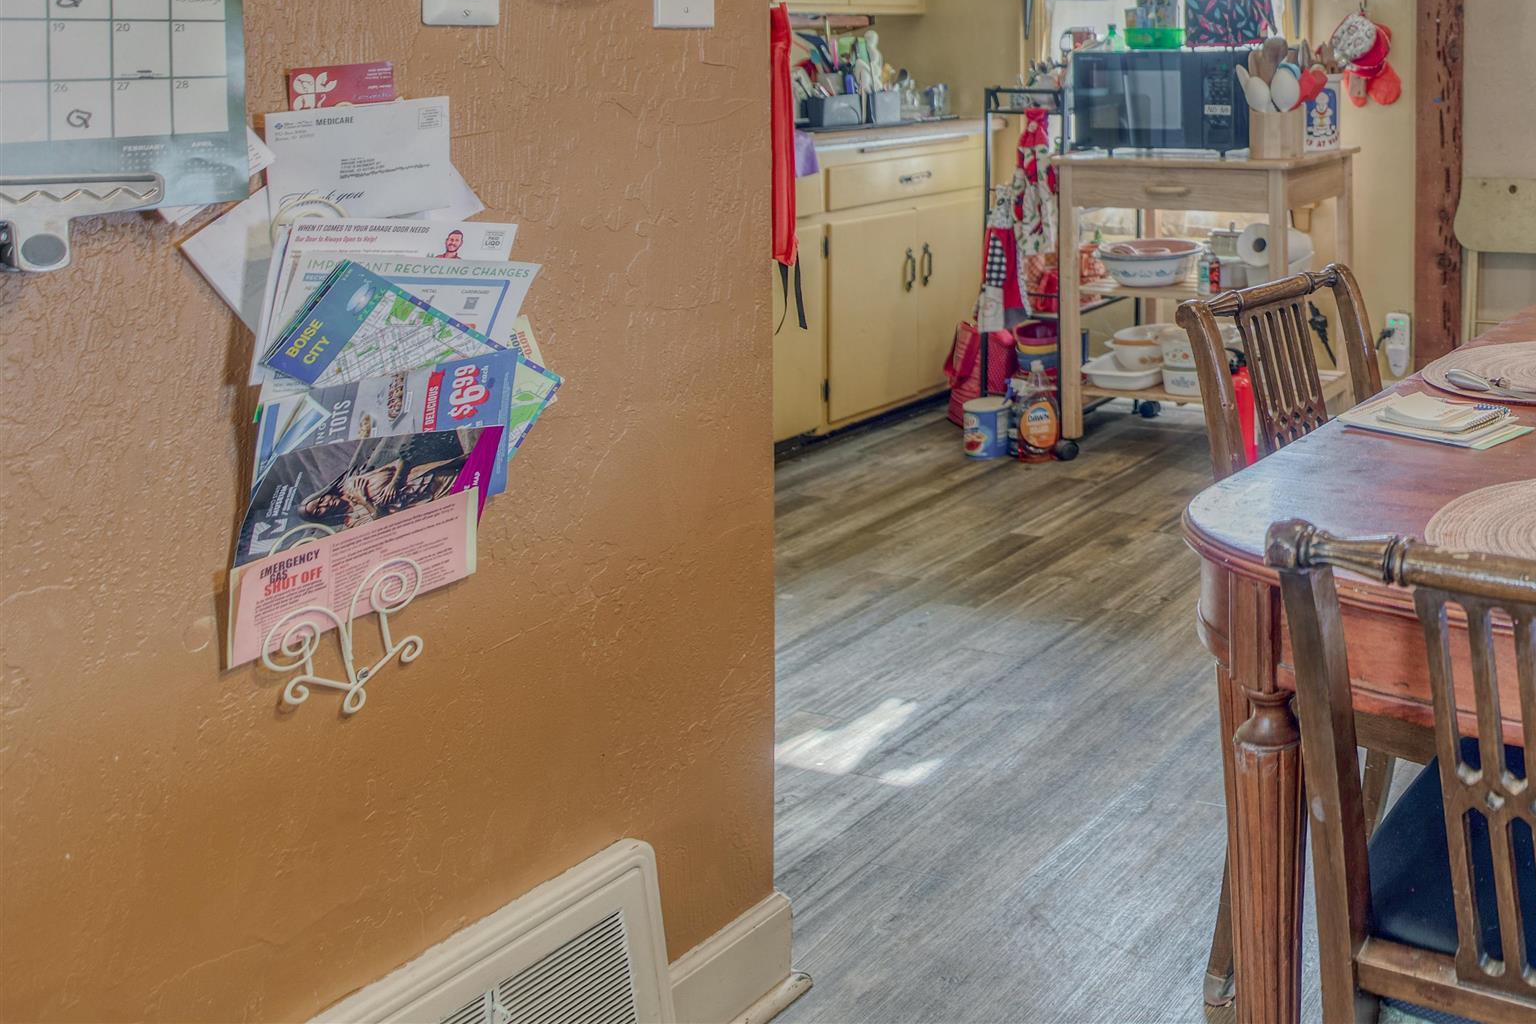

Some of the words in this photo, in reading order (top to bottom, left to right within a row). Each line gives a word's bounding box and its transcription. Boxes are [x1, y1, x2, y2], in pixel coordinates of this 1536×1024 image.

[53, 22, 66, 32] 19
[115, 23, 131, 33] 20
[174, 23, 186, 33] 21
[53, 83, 68, 93] 26
[116, 81, 130, 91] 27
[175, 80, 190, 90] 28
[315, 116, 355, 127] MEDICARE
[122, 144, 166, 153] FEBRUARY
[191, 141, 214, 149] APRIL
[335, 190, 366, 205] you
[297, 224, 316, 232] WHEN
[323, 224, 344, 233] COMES
[344, 225, 353, 233] TO
[353, 225, 369, 233] YOUR
[369, 225, 391, 233] GARAGE
[392, 226, 410, 234] DOOR
[409, 226, 431, 234] NEEDS
[394, 263, 469, 276] RECYCLING
[472, 266, 530, 278] CHANGES
[285, 319, 324, 358] BOISE
[303, 336, 331, 365] CITY
[424, 385, 439, 423] DELICIOUS
[329, 399, 351, 434] TOTS
[272, 484, 288, 517] MUSEUM
[260, 548, 321, 580] EMERGENCY
[264, 574, 298, 597] SHUT
[301, 566, 323, 584] OFF
[270, 569, 288, 585] GAS
